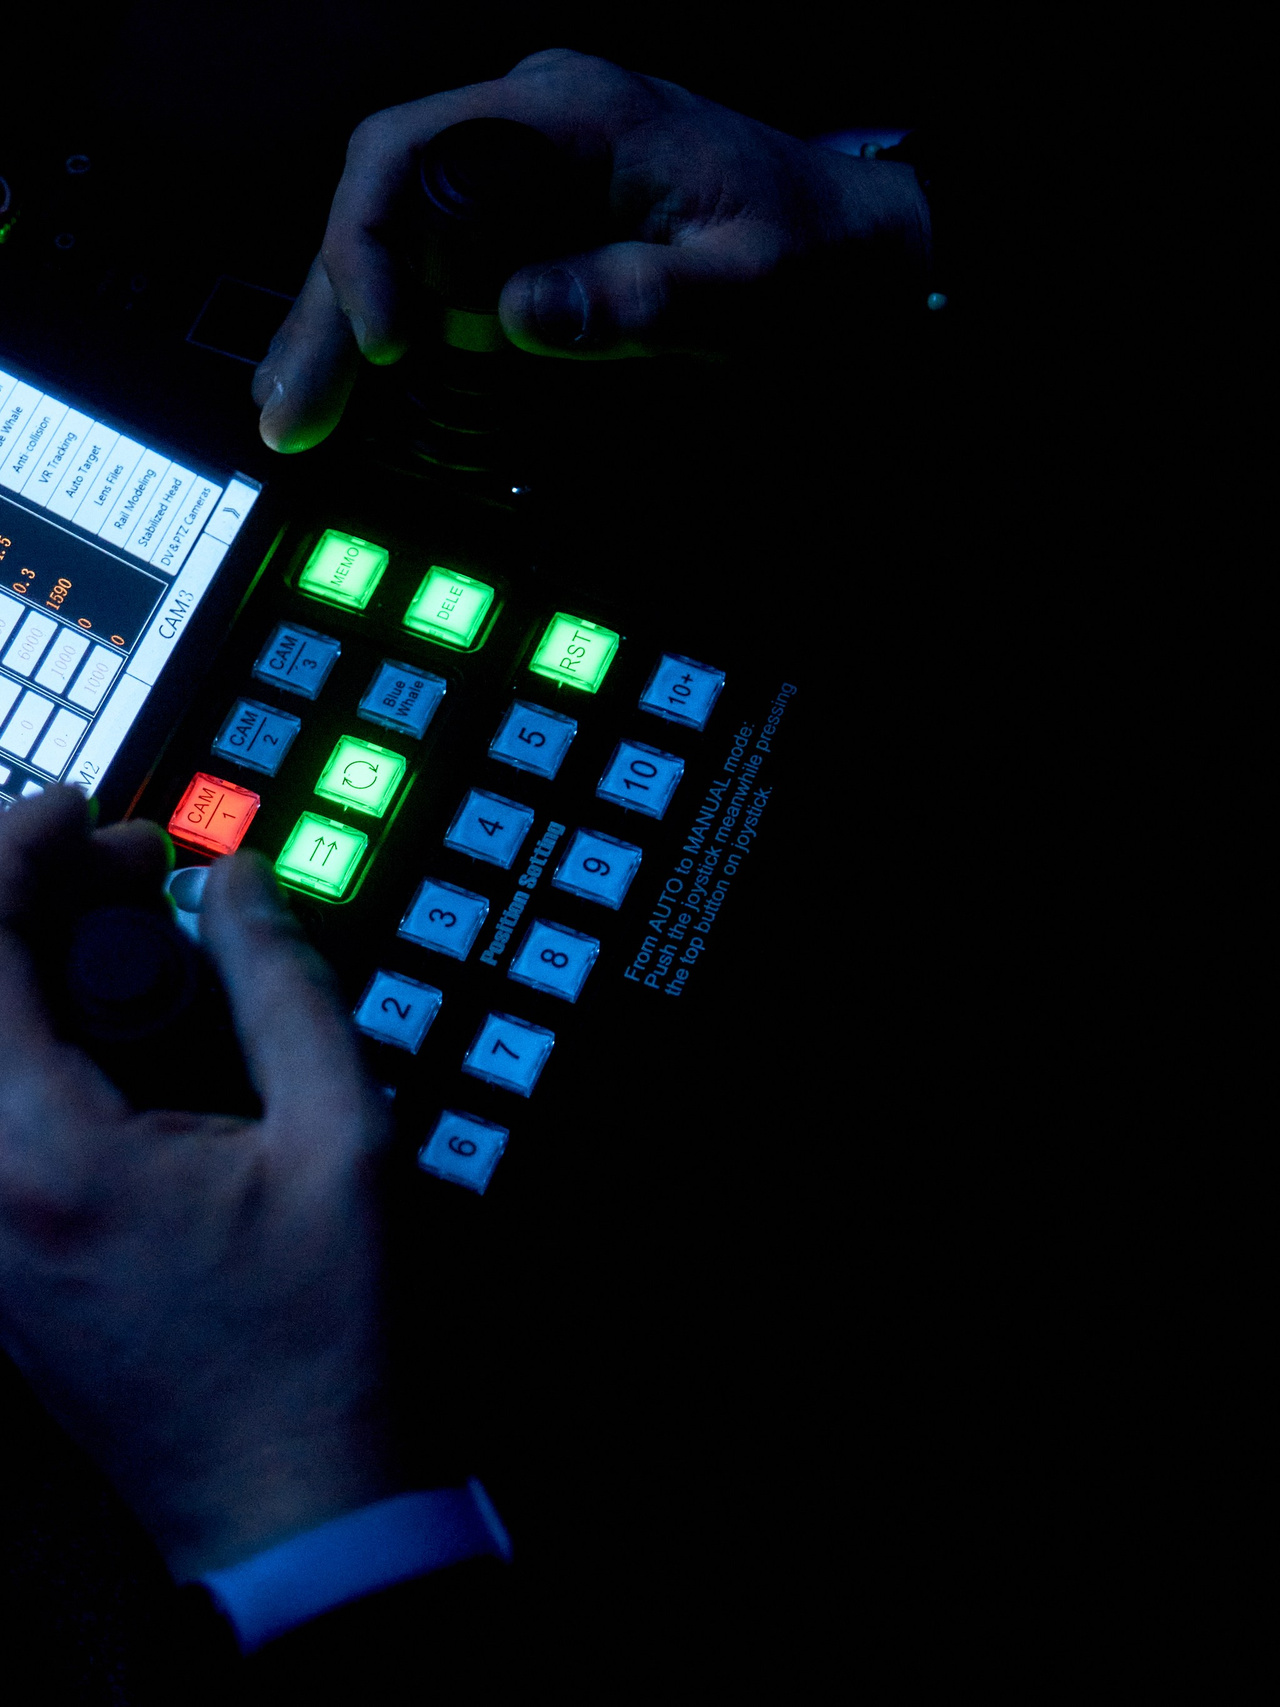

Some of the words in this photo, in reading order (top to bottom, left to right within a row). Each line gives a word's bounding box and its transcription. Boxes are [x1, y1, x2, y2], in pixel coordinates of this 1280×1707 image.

[0, 406, 23, 434] Whale
[37, 469, 53, 483] VR
[46, 431, 78, 468] Tracking
[65, 475, 84, 498] Auto
[77, 444, 102, 473] Target
[93, 485, 112, 507] Lens
[105, 464, 124, 484] Files
[113, 510, 130, 530] Rail
[123, 468, 157, 512] Modeling
[137, 502, 168, 548] Stabilized
[162, 477, 183, 503] Head
[183, 487, 211, 526] Cameras
[11, 567, 36, 594] 0.3
[329, 541, 360, 587] MEMO
[45, 577, 72, 610] 1590
[435, 585, 464, 621] DELE
[77, 617, 92, 629] 0
[157, 589, 194, 640] CAM3
[16, 625, 45, 662] 6000
[110, 634, 125, 646] 0
[268, 634, 298, 670] CAM
[558, 629, 591, 673] RST
[49, 643, 78, 678] 1000
[82, 660, 111, 695] 1000
[301, 658, 318, 670] 3
[381, 680, 406, 708] Blue
[395, 680, 425, 717] Whale
[667, 673, 693, 705] 10+
[19, 718, 35, 732] 0
[228, 709, 259, 747] CAM
[262, 733, 279, 746] 2
[517, 726, 546, 748] 5
[52, 735, 69, 750] 0
[722, 720, 755, 773] mode:
[622, 759, 658, 791] 10
[186, 786, 216, 824] CAM
[221, 811, 237, 819] 1
[681, 777, 732, 855] MANUAL
[729, 785, 773, 854] joystick.
[477, 816, 504, 837] 4
[642, 943, 678, 990] Push
[666, 912, 692, 941] the
[679, 844, 723, 913] joystick
[713, 753, 763, 844] meanwhile
[754, 681, 798, 753] pressing
[582, 856, 611, 877] 9
[673, 857, 694, 875] to
[722, 853, 742, 876] on
[479, 890, 530, 967] Position
[517, 820, 566, 889] Setting
[647, 877, 684, 934] AUTO
[692, 879, 731, 934] button
[428, 907, 457, 928] 3
[539, 948, 569, 969] 8
[623, 934, 659, 982] From
[678, 936, 706, 965] top
[663, 967, 690, 997] the
[380, 996, 412, 1021] 2
[490, 1038, 520, 1060] 7
[447, 1135, 477, 1157] 6
